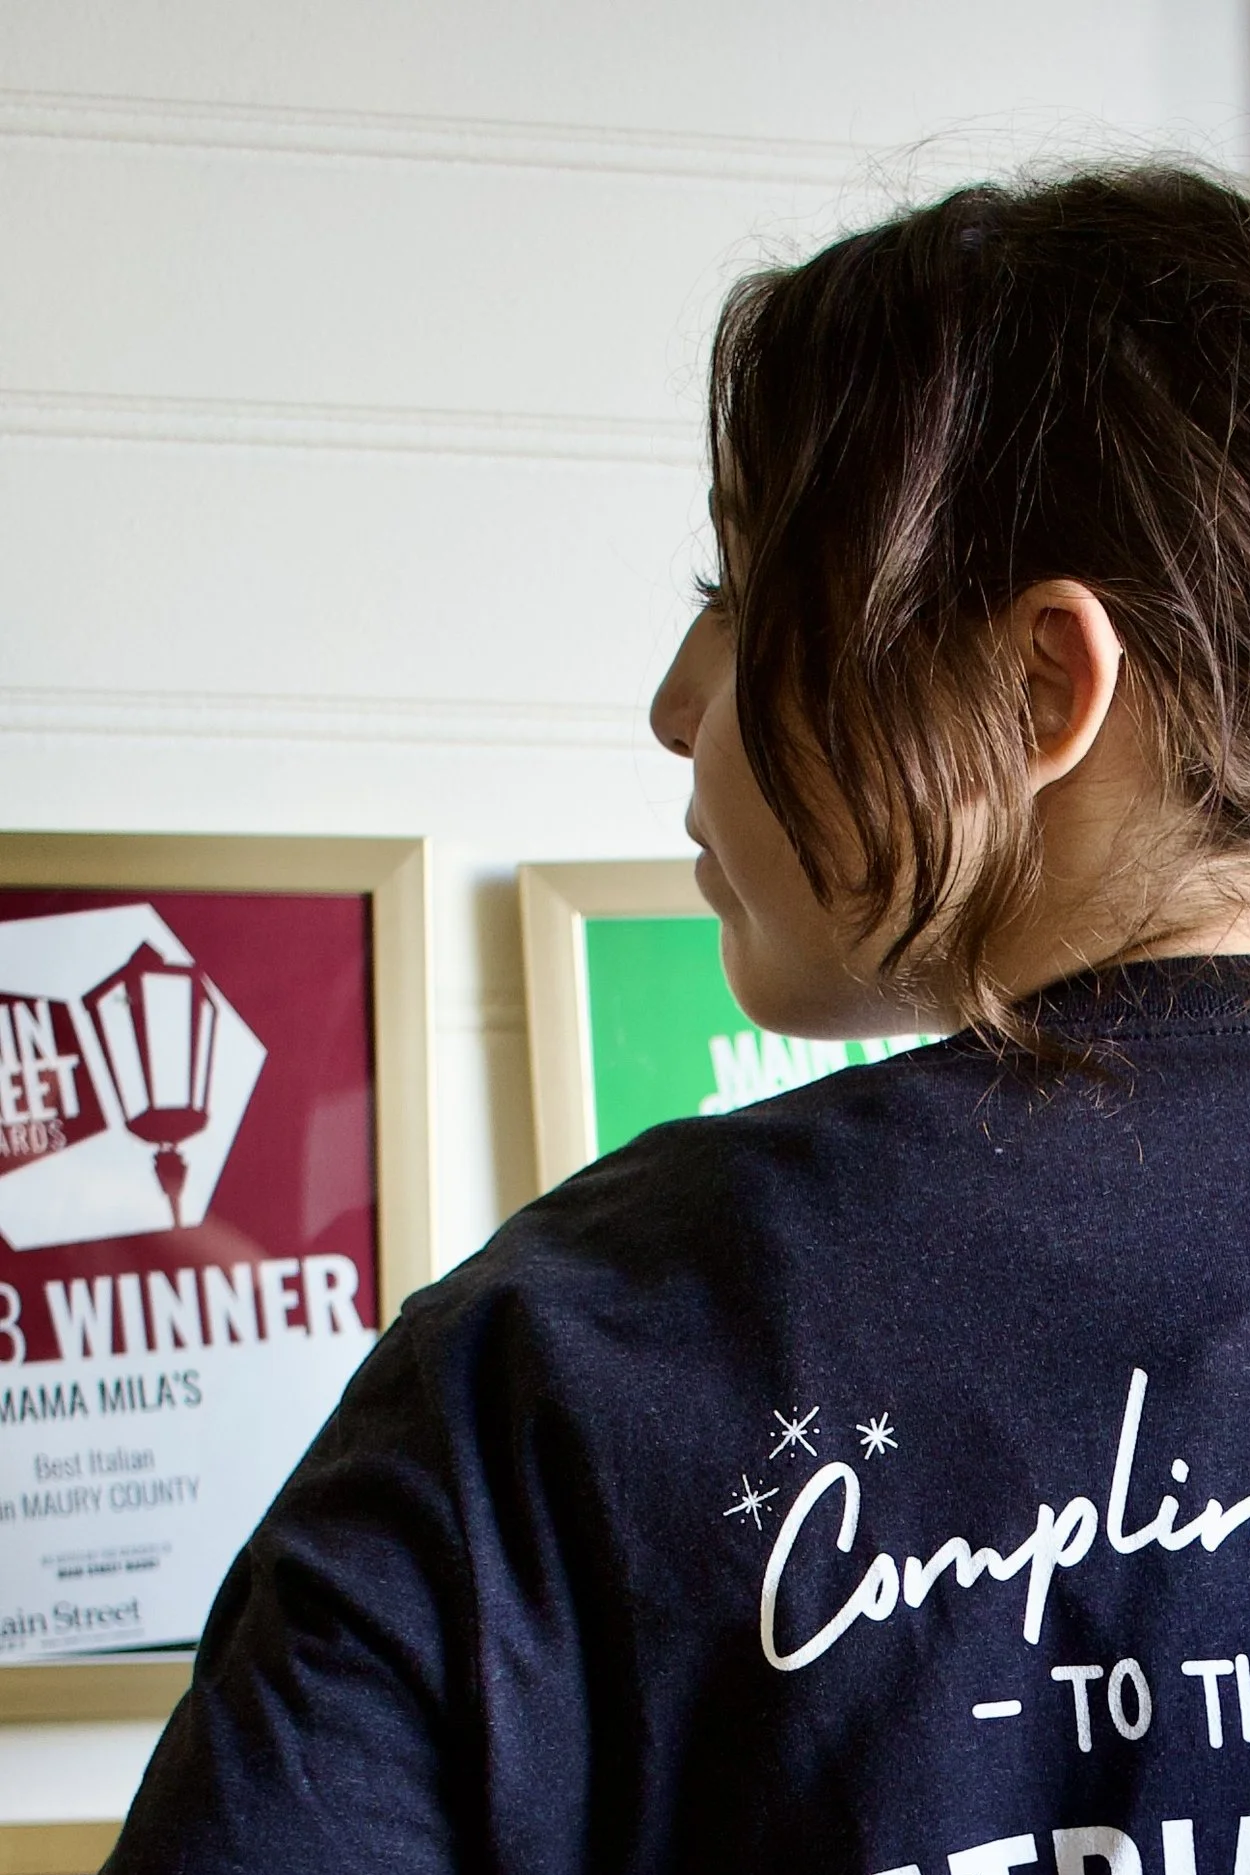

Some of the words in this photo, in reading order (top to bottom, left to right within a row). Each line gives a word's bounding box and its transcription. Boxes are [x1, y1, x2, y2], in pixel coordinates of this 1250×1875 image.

[46, 1253, 370, 1366] WINNER
[99, 1369, 203, 1414] MILA'S
[34, 1452, 82, 1481] Best
[89, 1447, 155, 1476] Italian
[22, 1486, 101, 1519] MAURY
[110, 1475, 199, 1513] COUNTY
[53, 1598, 140, 1631] Street
[1051, 1657, 1152, 1752] TO
